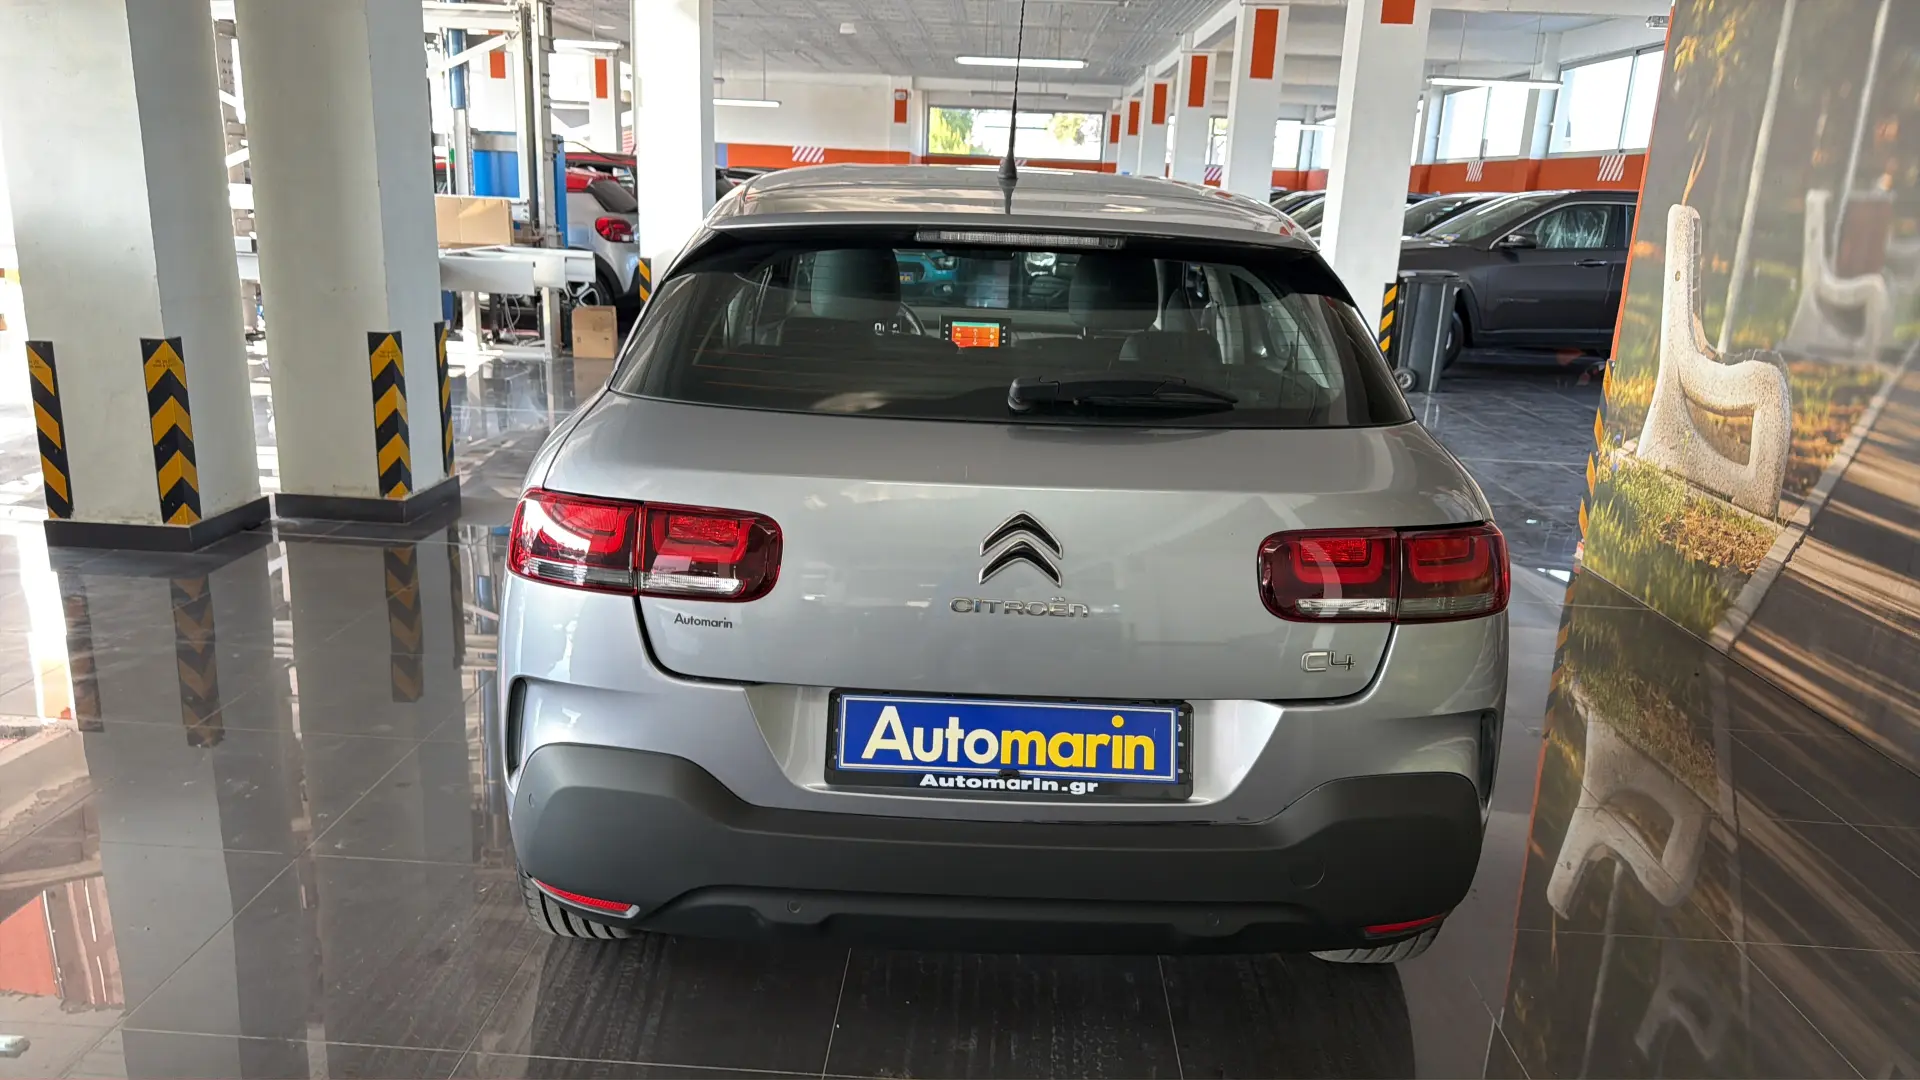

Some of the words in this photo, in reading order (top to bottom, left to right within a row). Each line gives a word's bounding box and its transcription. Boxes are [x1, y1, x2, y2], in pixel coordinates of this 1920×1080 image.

[674, 613, 733, 629] Automarin
[1301, 651, 1356, 672] C4
[861, 705, 1155, 770] Automarin
[919, 773, 1099, 795] Automarin.gr
